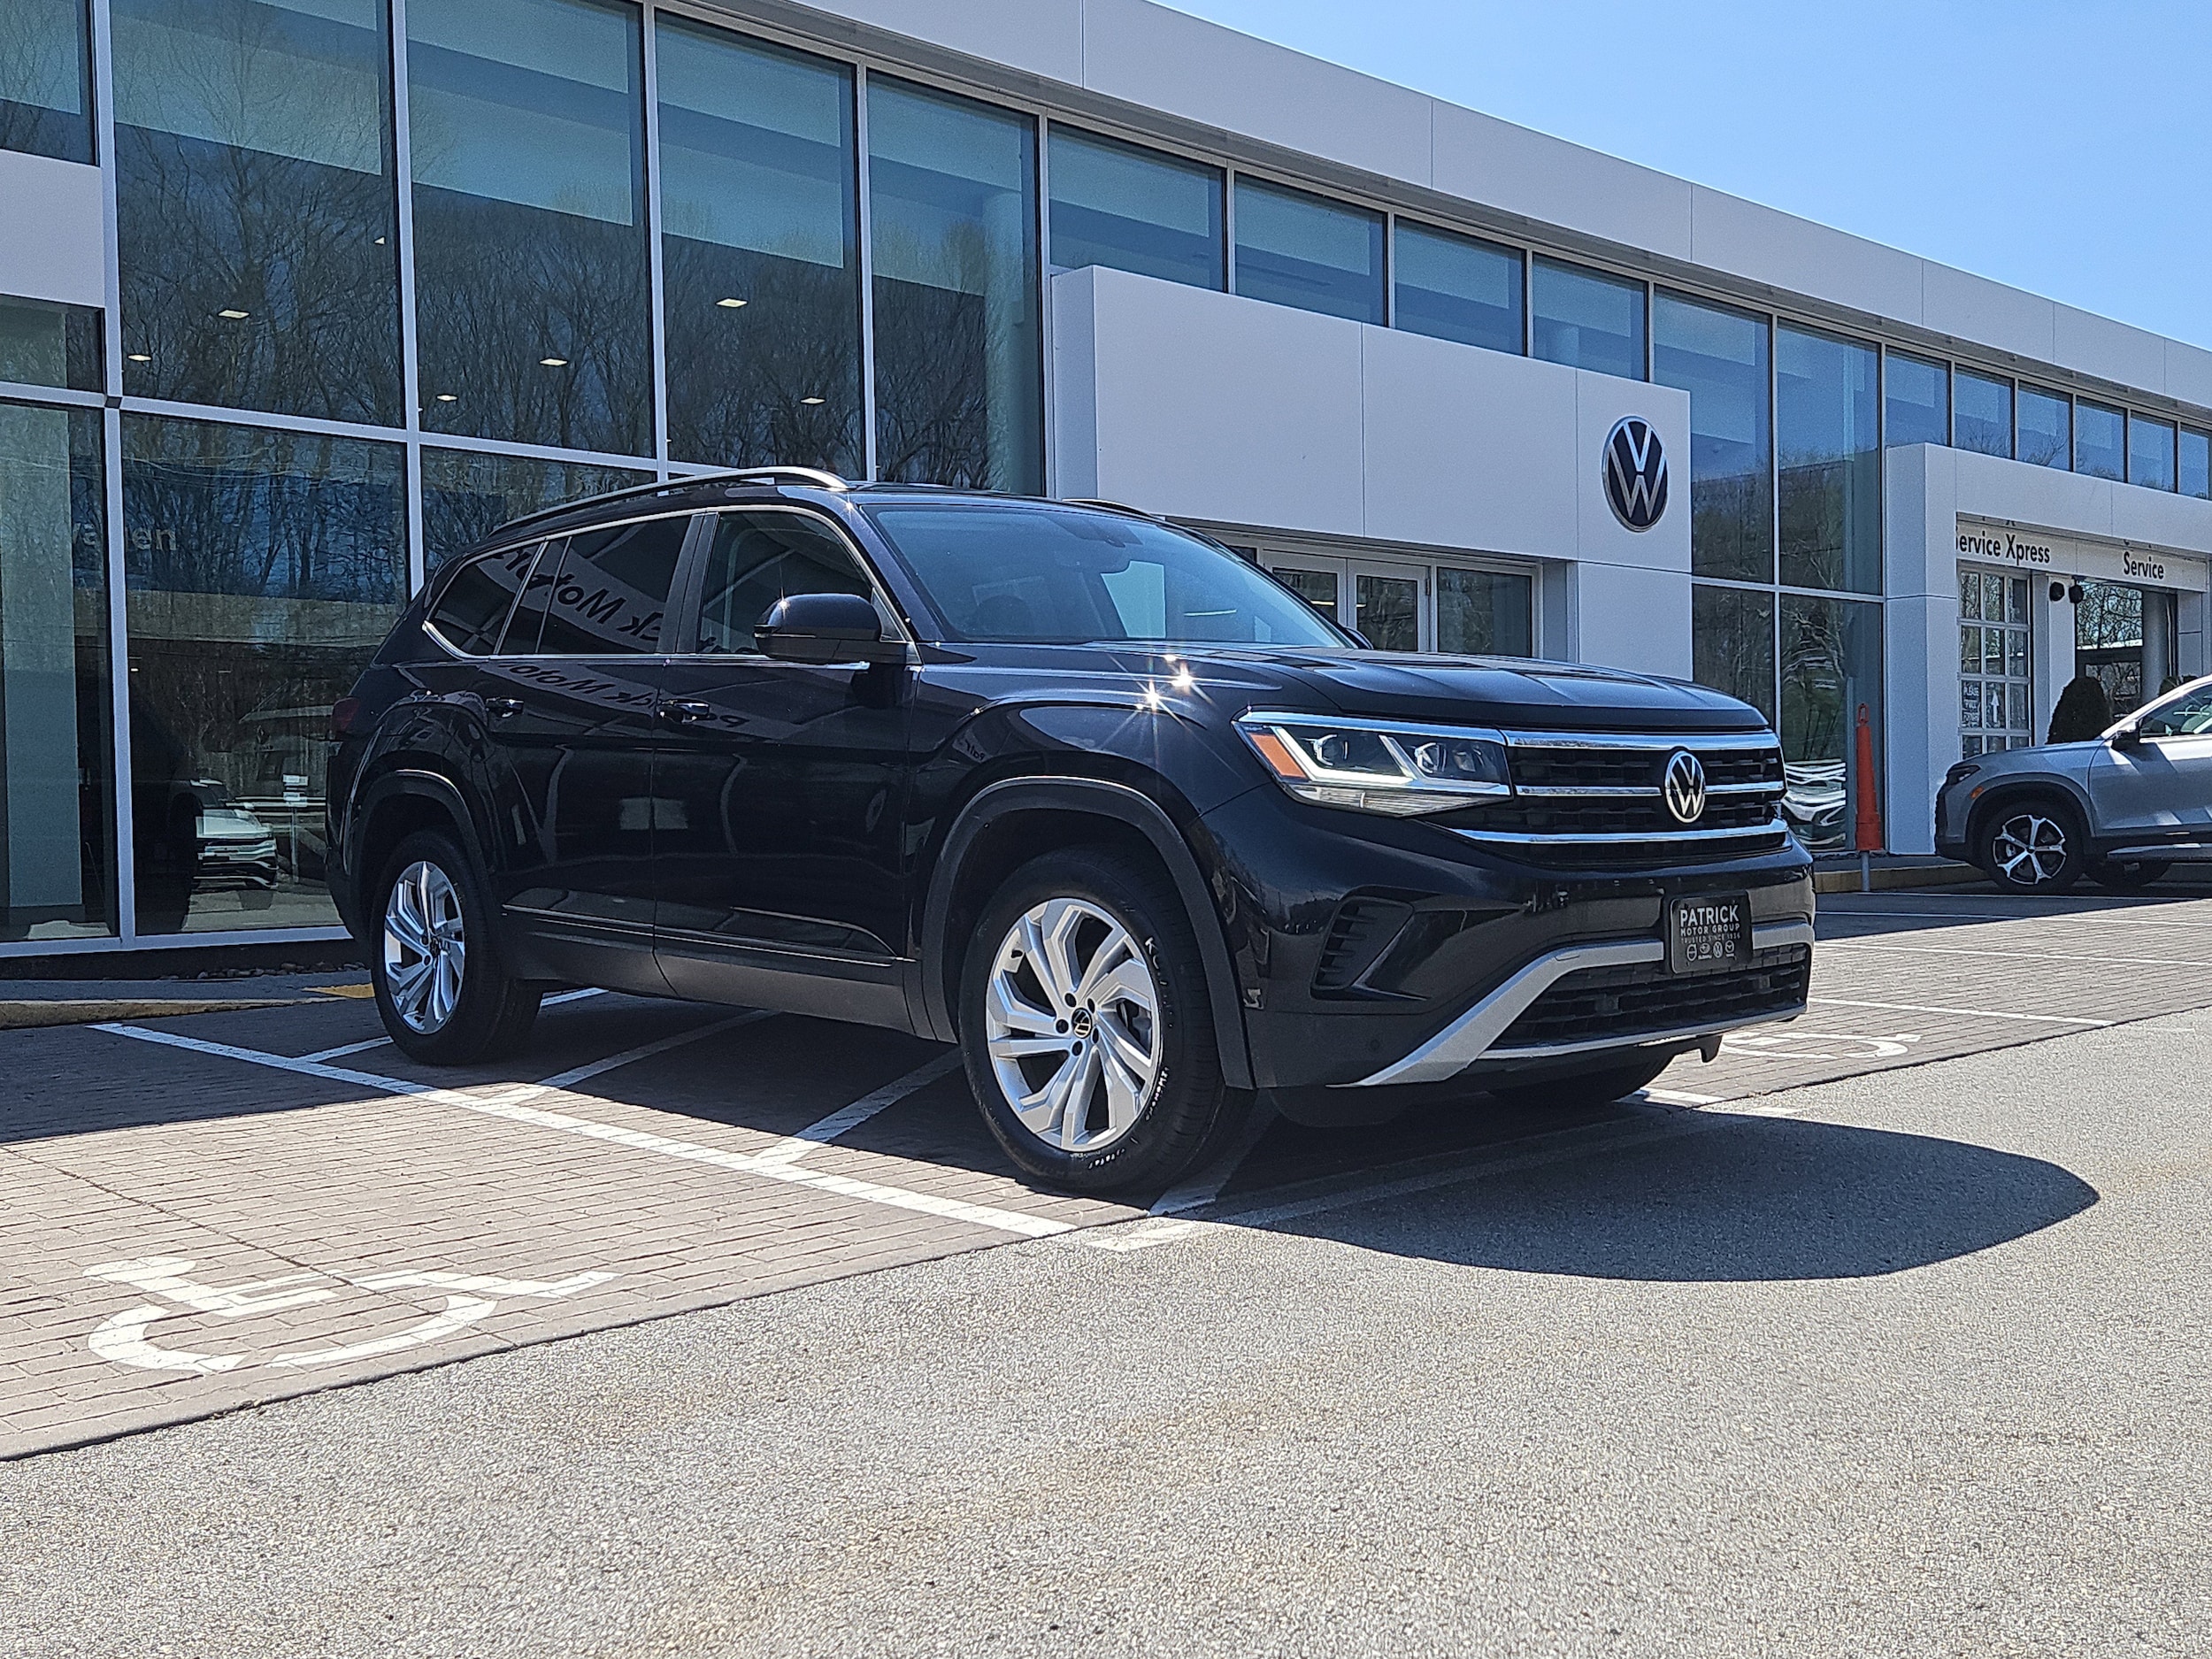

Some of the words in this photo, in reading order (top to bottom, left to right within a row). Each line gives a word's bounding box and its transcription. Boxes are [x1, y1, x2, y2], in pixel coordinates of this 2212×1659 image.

[1602, 416, 1668, 532] VW
[2005, 534, 2051, 565] Xpress
[2124, 550, 2164, 580] Service
[1665, 750, 1706, 823] VW
[1680, 904, 1740, 927] PATRICK
[1680, 926, 1709, 937] MOTOR
[1711, 922, 1740, 933] GROUP
